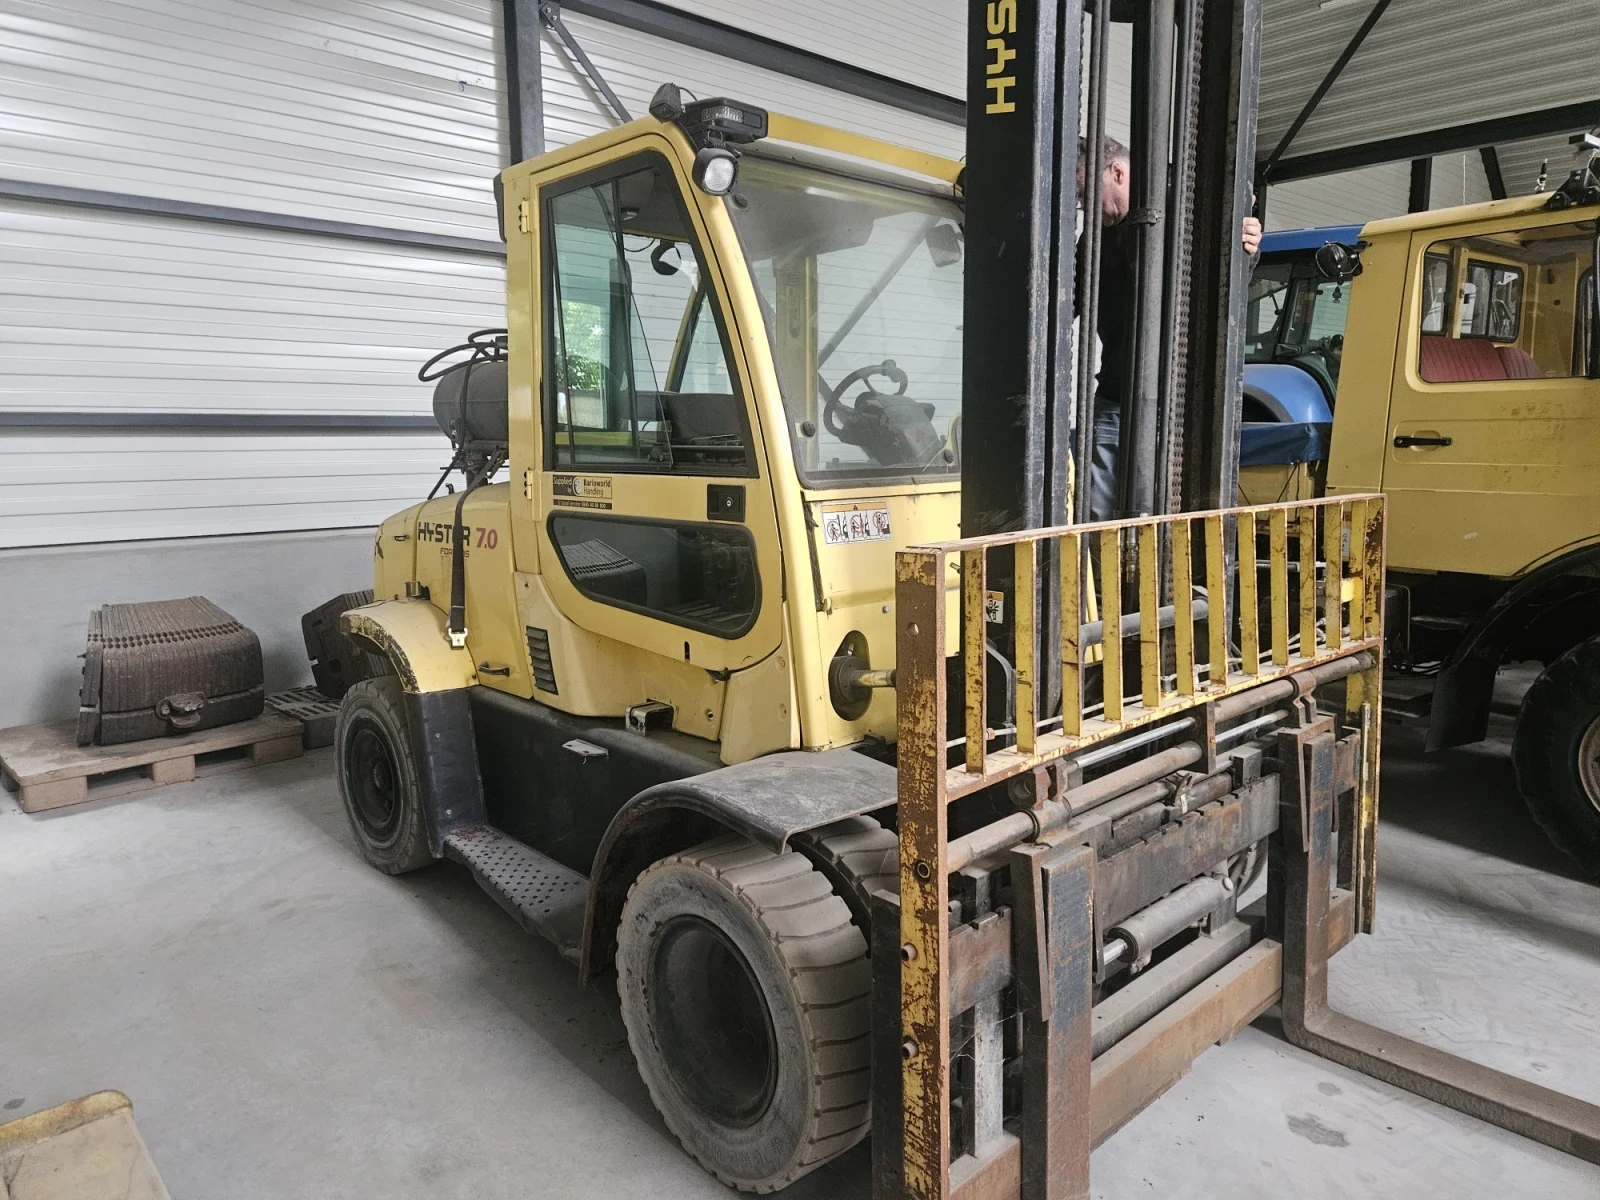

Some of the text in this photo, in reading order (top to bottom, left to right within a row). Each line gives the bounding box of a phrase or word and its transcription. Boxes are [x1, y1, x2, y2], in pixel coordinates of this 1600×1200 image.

[553, 477, 573, 486] Supplied
[583, 479, 611, 488] Barloworld
[583, 488, 604, 497] Handling
[418, 521, 498, 549] HYSTR 7.0
